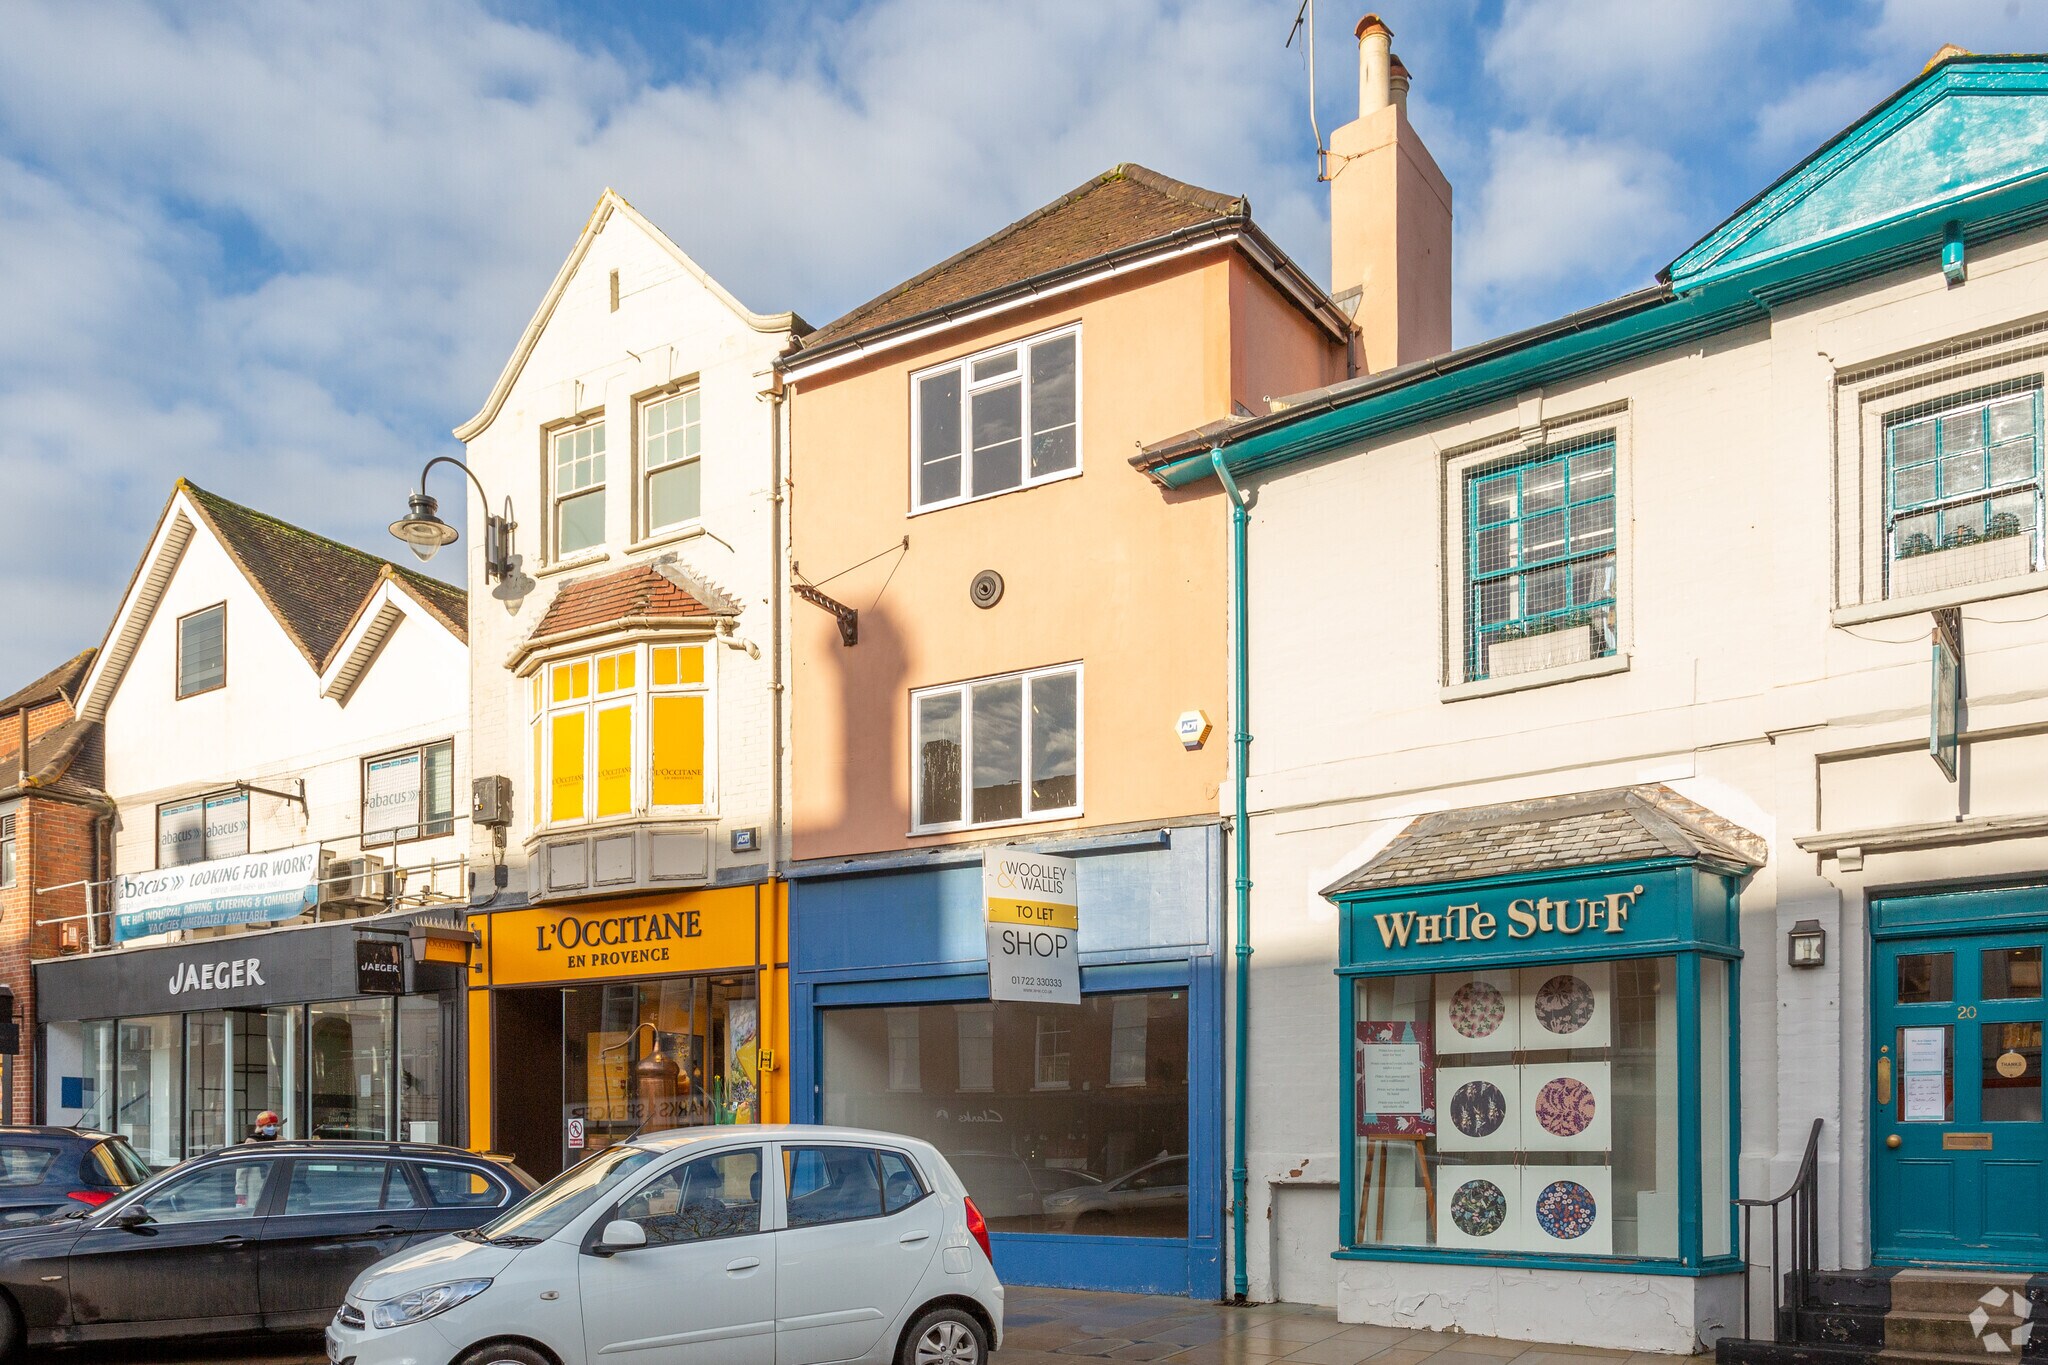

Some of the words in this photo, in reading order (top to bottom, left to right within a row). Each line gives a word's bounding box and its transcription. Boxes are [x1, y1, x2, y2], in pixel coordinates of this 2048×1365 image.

[1182, 720, 1197, 732] ADT
[655, 768, 703, 776] L'OCCITANE
[369, 790, 406, 808] abacus
[161, 828, 193, 845] abacus
[206, 821, 238, 838] abacus
[119, 876, 168, 899] abacus
[189, 866, 240, 887] LOOKING
[243, 862, 268, 879] FOR
[272, 854, 313, 876] WORK?
[997, 860, 1017, 889] &
[1021, 877, 1063, 894] WALLIS
[1006, 861, 1067, 880] WOOLLEY
[120, 916, 130, 926] WE
[216, 896, 252, 910] CATERING
[254, 897, 260, 906] &
[227, 910, 268, 923] AVAILABLE
[1016, 906, 1032, 918] TO
[1037, 907, 1054, 920] LET
[536, 910, 702, 951] L'OCCITANE
[1002, 930, 1068, 958] SHOP
[567, 954, 586, 968] EN
[591, 947, 670, 967] PROVENCE
[361, 962, 400, 973] JAEGER
[169, 958, 266, 995] JAEGER
[1011, 976, 1035, 986] 01722
[1036, 977, 1063, 988] 330333
[1957, 1006, 1977, 1020] 20
